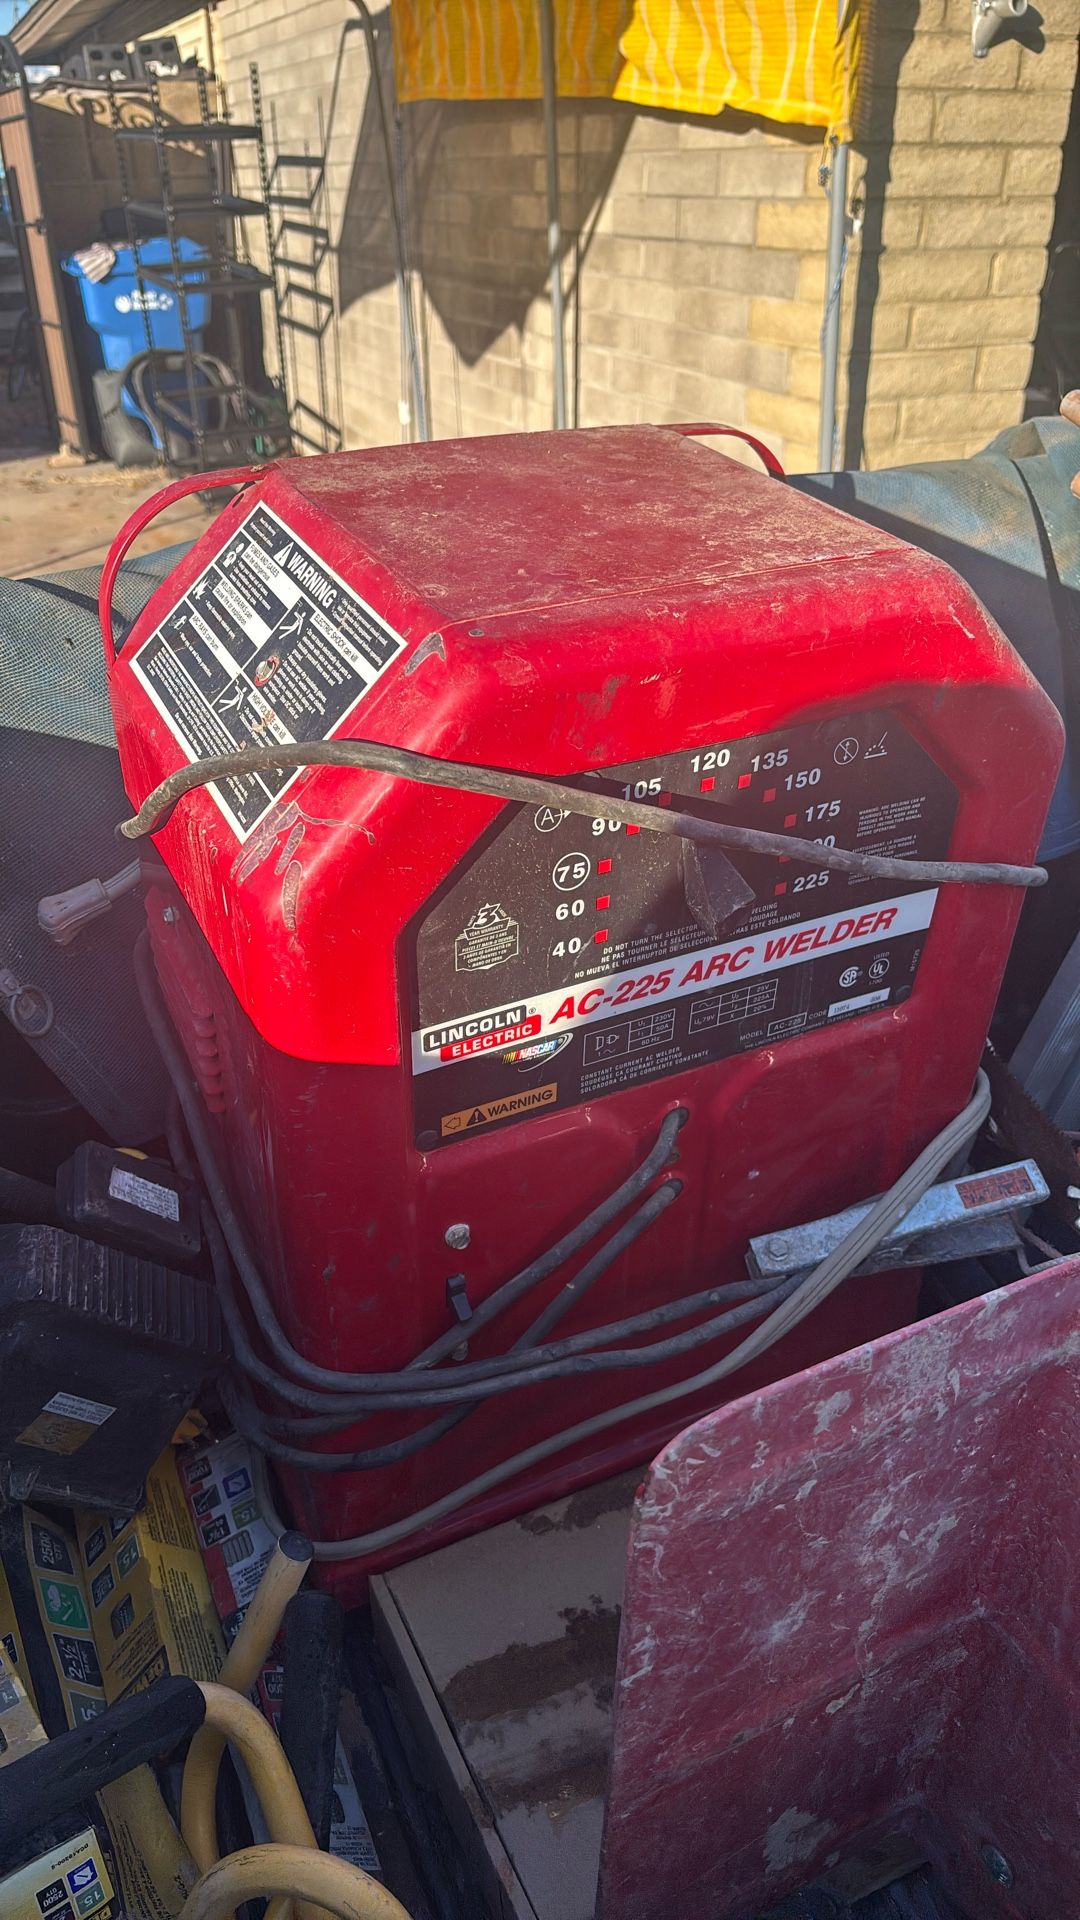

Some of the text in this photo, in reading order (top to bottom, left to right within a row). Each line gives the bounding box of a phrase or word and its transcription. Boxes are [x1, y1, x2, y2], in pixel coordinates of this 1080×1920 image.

[285, 551, 338, 608] WARNING
[691, 749, 730, 773] 120
[751, 748, 789, 773] 135
[622, 777, 662, 801] 105
[784, 768, 821, 792] 150
[805, 800, 841, 823] 175
[592, 818, 622, 836] 90
[557, 862, 586, 883] 75
[793, 871, 830, 893] 225
[555, 899, 585, 921] 60
[552, 937, 581, 958] 40
[603, 924, 698, 955] DO NOT TURN THE SELECTOR
[549, 906, 899, 1026] AC-225 ARC WELDER
[601, 954, 611, 963] NE
[612, 951, 625, 960] PAS
[575, 971, 585, 980] NO
[611, 960, 620, 969] EL
[429, 1008, 521, 1048] LINCOLN
[655, 1012, 673, 1023] 230V
[655, 1023, 669, 1033] 50A
[739, 1030, 764, 1041] MODEL
[774, 1017, 802, 1031] AC-225
[808, 1009, 827, 1020] CODE
[452, 1023, 533, 1057] ELECTRIC
[518, 1039, 556, 1062] NASCAR
[641, 1038, 650, 1046] 60
[580, 1066, 614, 1081] CONSTANT
[615, 1059, 643, 1071] CURRENT
[655, 1046, 681, 1058] WELDER
[487, 1089, 553, 1118] WARNING
[39, 1530, 56, 1565] 2500
[43, 1890, 64, 1907] 2500
